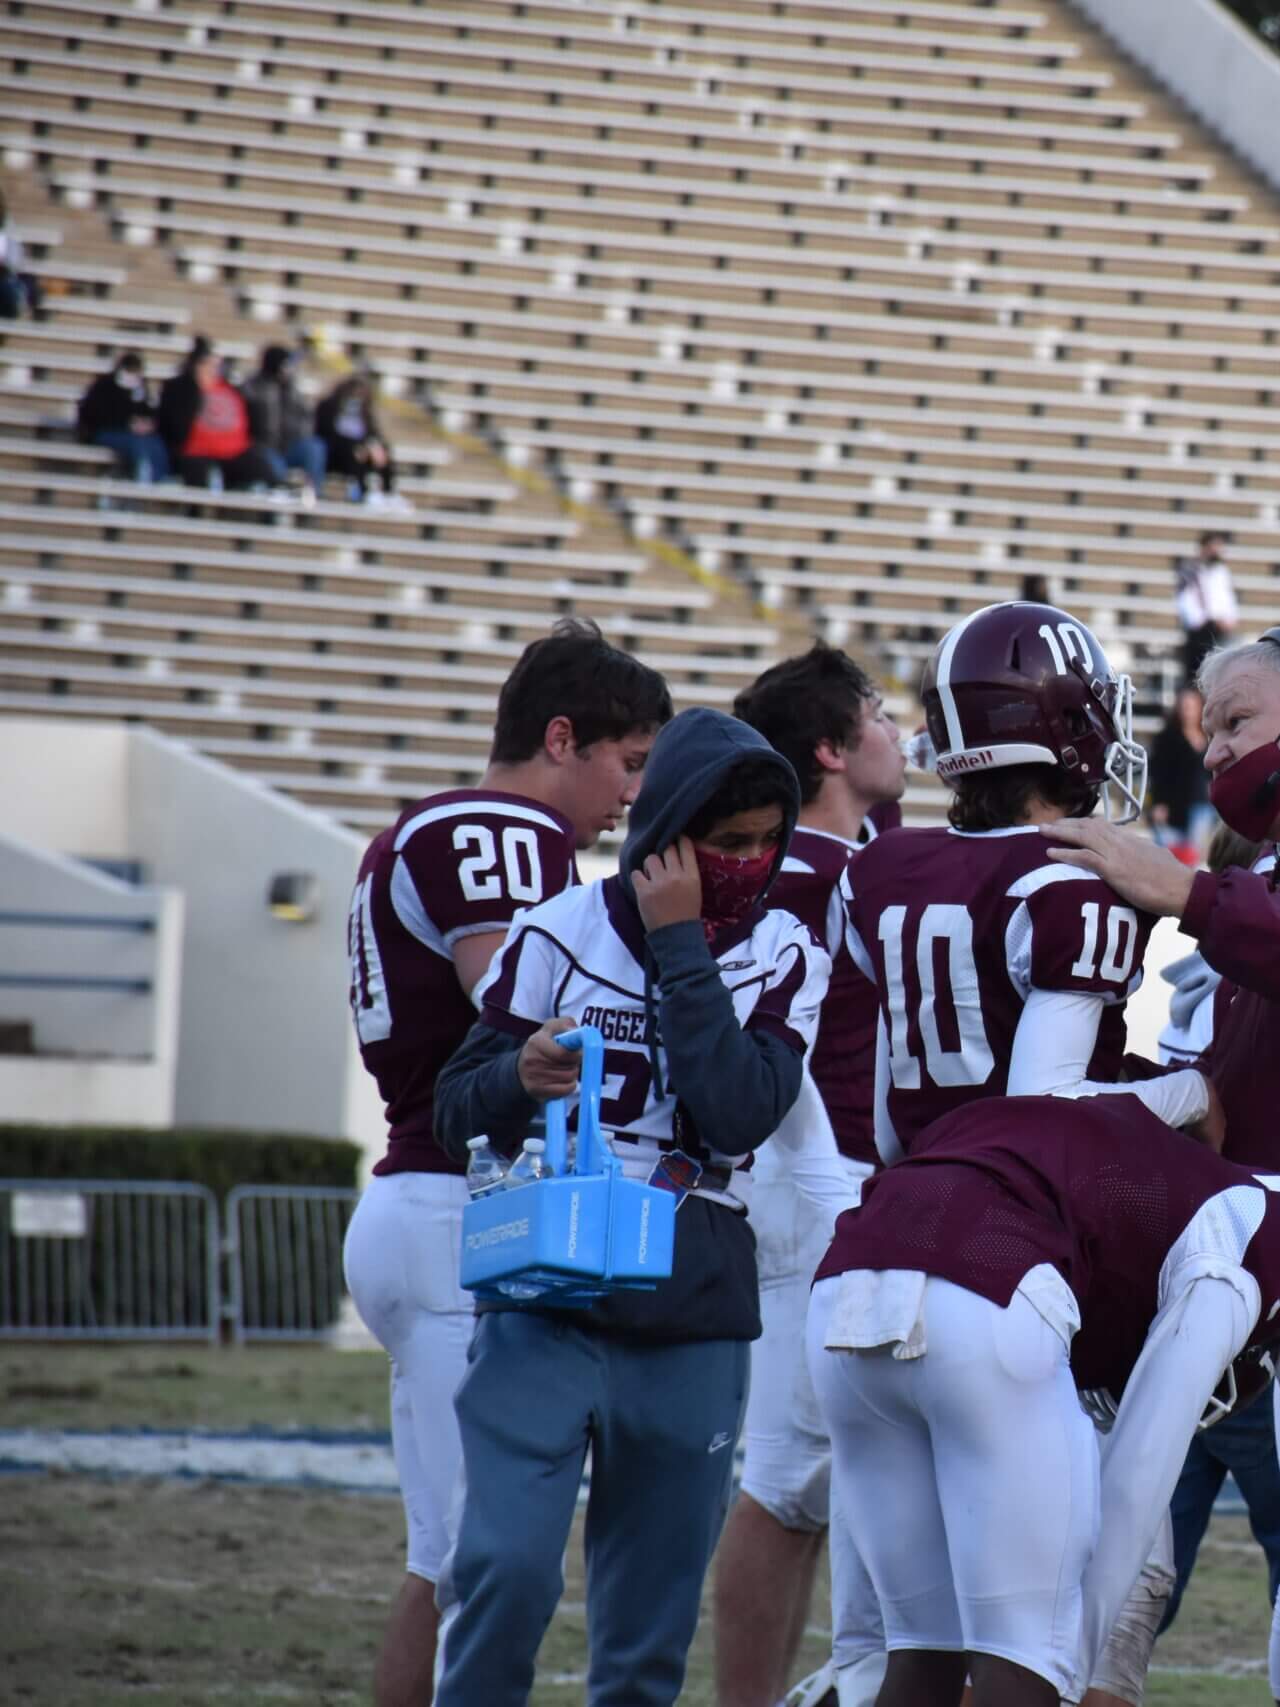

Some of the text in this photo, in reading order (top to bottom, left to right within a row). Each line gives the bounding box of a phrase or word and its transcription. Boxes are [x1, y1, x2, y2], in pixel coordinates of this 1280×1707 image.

[1038, 622, 1094, 676] 10
[452, 824, 543, 903] 20
[1071, 901, 1138, 983] 10
[878, 903, 995, 1090] 10
